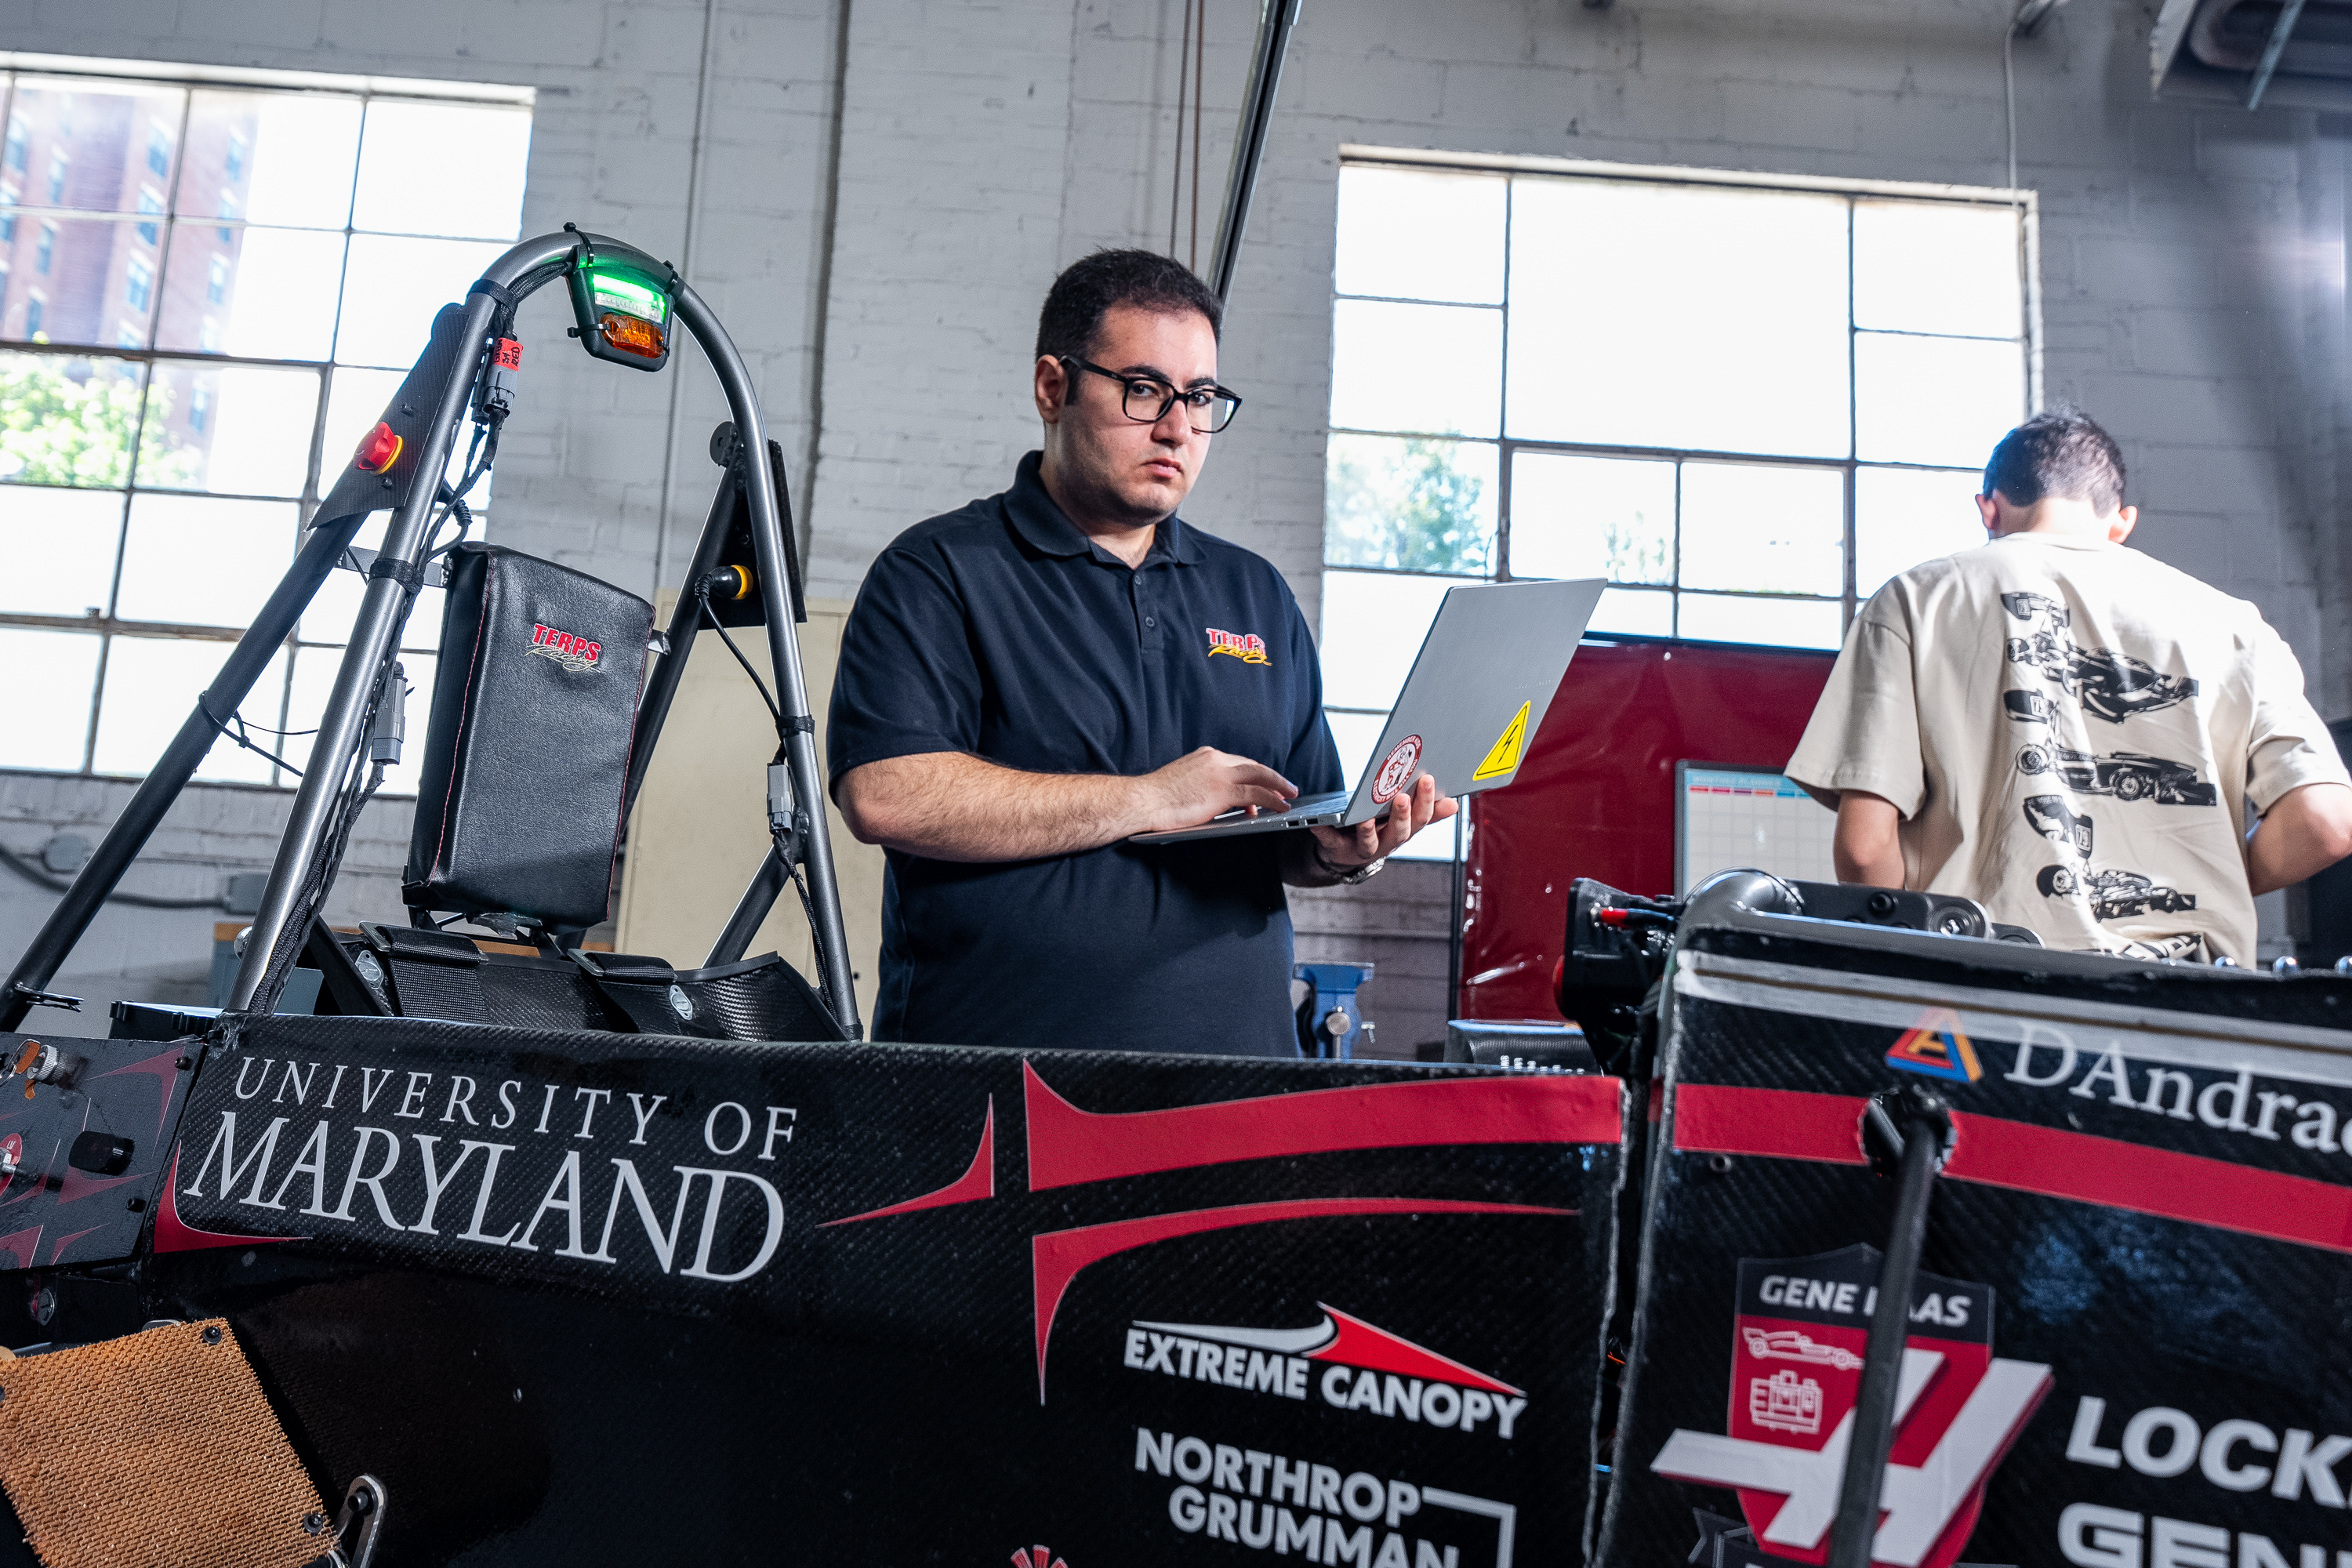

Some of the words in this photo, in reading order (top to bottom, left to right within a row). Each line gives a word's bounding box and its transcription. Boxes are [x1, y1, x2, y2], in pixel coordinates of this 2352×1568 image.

[511, 347, 521, 367] RED
[532, 623, 601, 662] TERPS
[1410, 759, 1418, 773] YOU
[235, 1057, 668, 1146] UNIVERSITY
[704, 1101, 797, 1161] OF
[183, 1111, 784, 1283] MARYLAND
[1759, 1275, 1860, 1314] GENE
[1123, 1328, 1310, 1401] EXTREME
[1320, 1365, 1528, 1439] CANOPY
[1134, 1427, 1421, 1529] NORTHROP
[2065, 1395, 2352, 1510] LOCK
